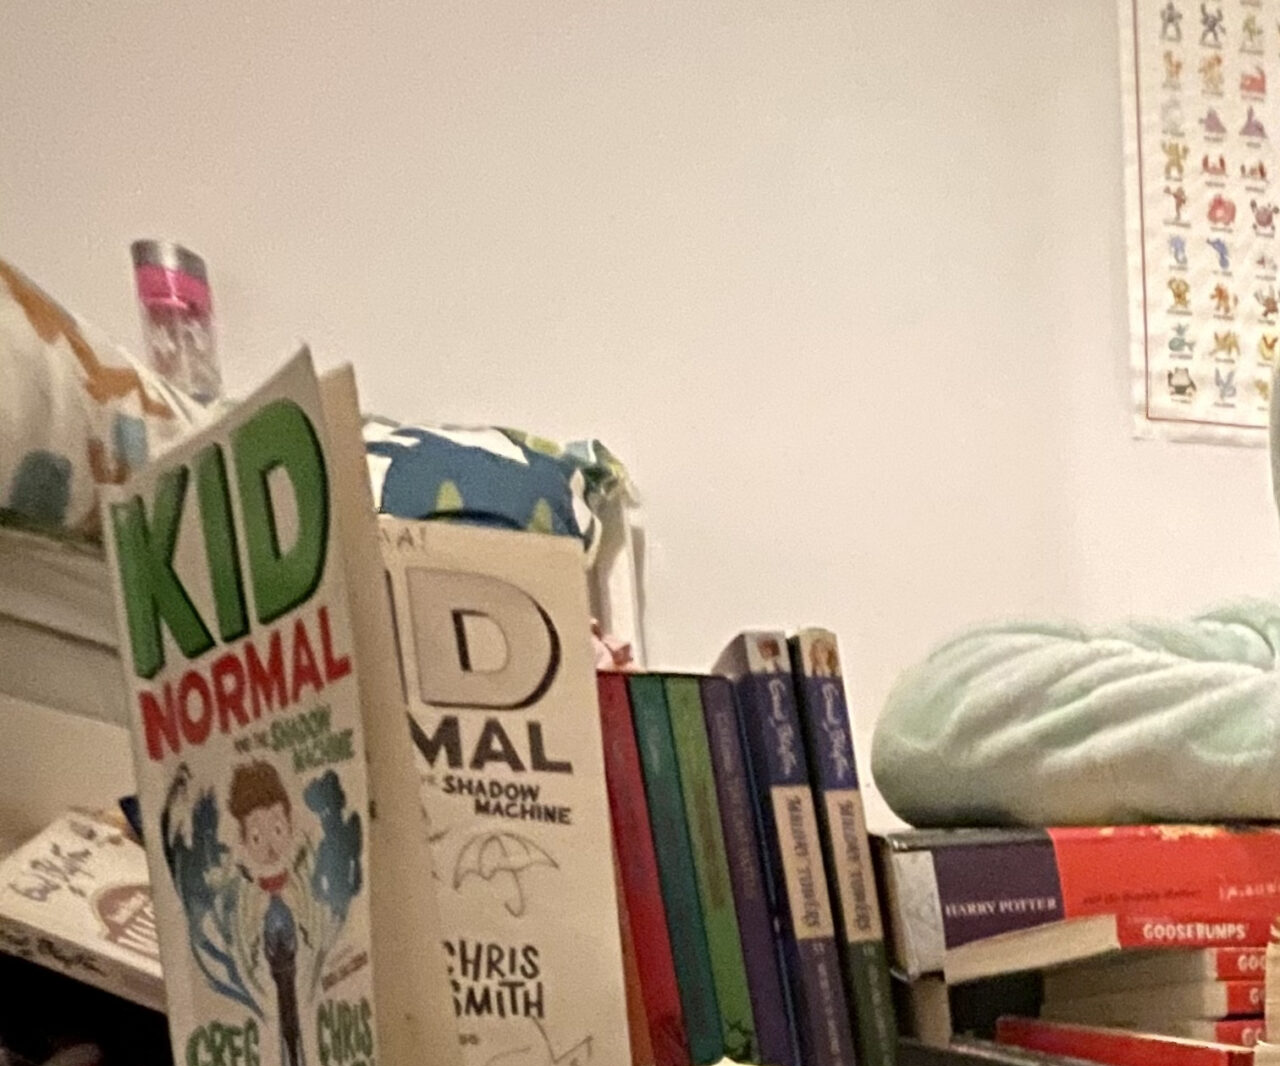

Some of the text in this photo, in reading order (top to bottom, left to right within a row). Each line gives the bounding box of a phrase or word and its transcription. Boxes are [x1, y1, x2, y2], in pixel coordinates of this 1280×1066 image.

[109, 398, 331, 680] KID
[137, 606, 352, 761] NORMAL
[442, 775, 541, 803] SHADOW
[475, 799, 574, 826] MACHINE
[945, 897, 1057, 918] HARRY POTTER
[1143, 922, 1247, 941] GOOSEBUMPS
